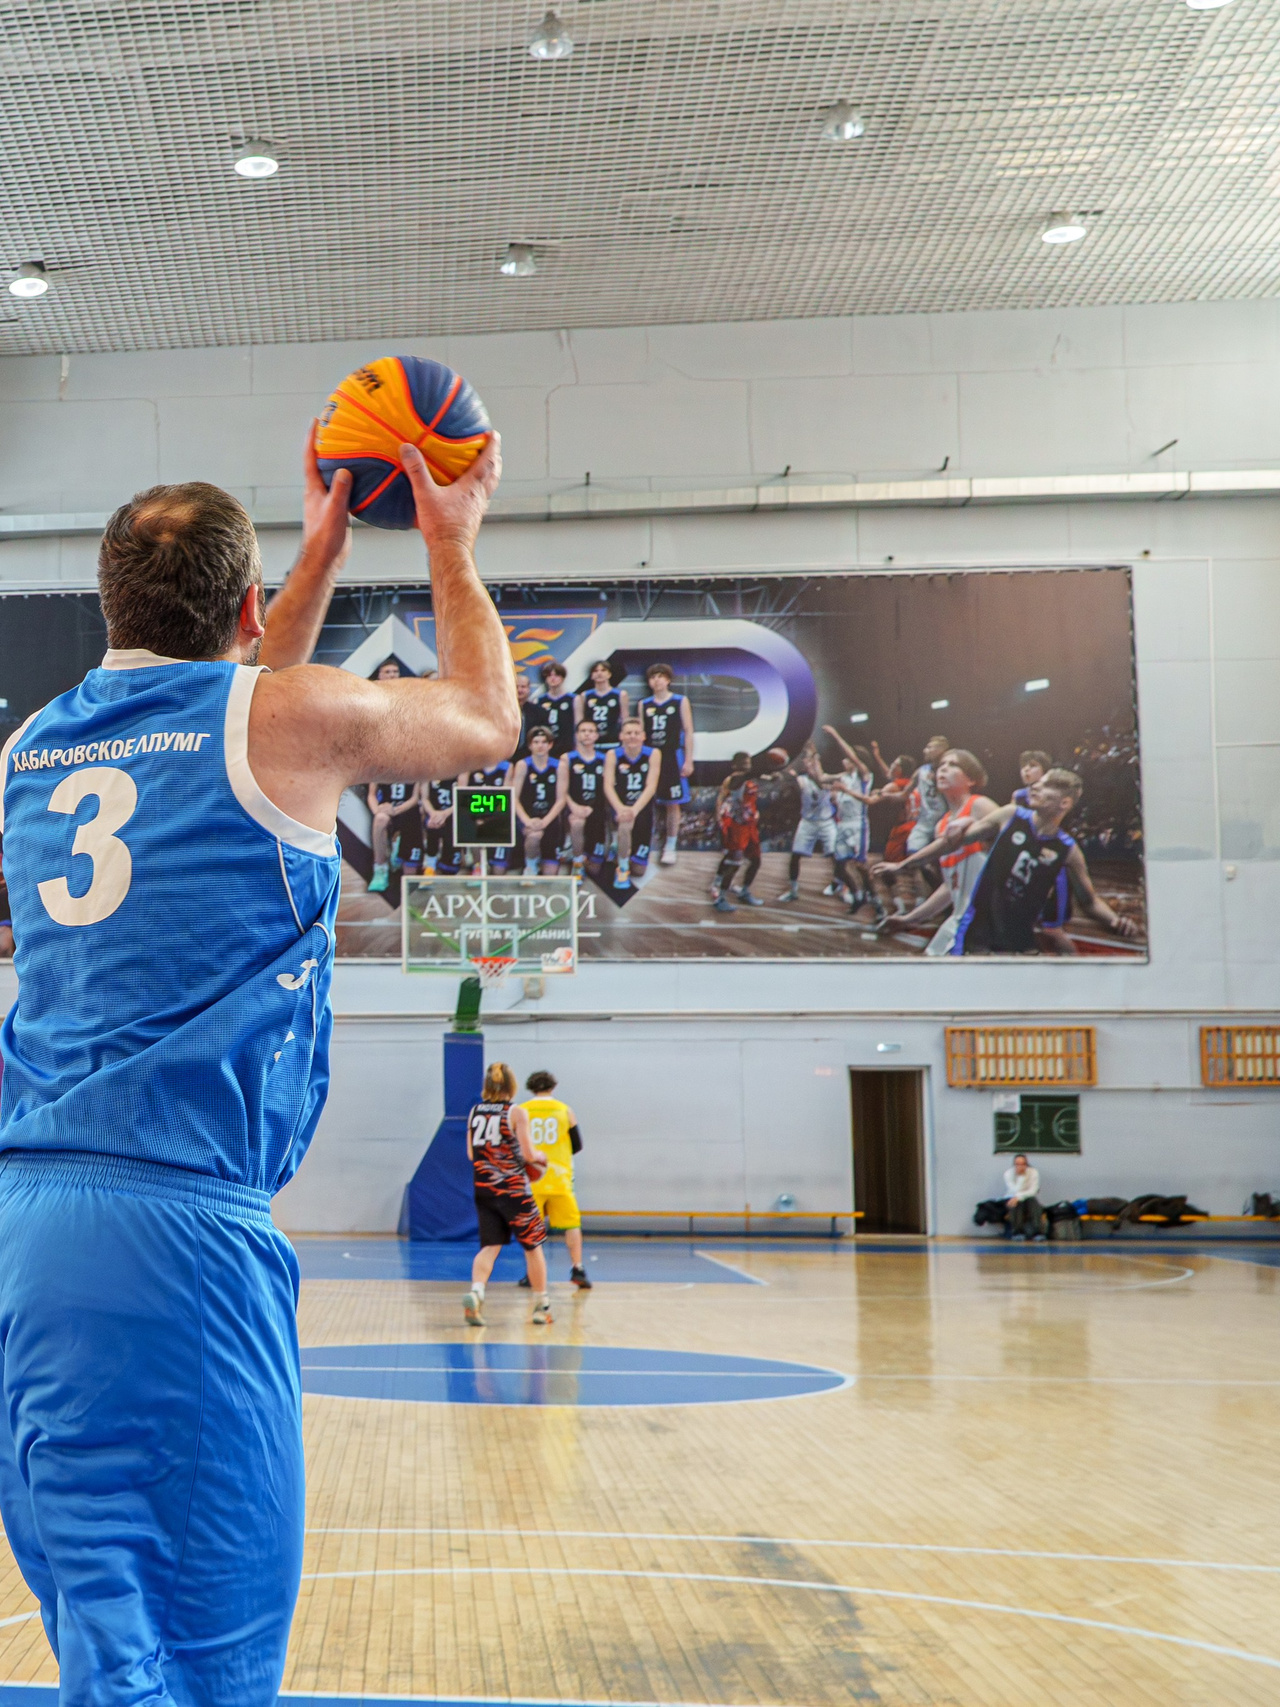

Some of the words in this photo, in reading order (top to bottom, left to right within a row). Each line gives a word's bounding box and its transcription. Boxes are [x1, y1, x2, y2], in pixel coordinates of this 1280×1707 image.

[626, 773, 642, 789] 12
[37, 766, 138, 926] 3
[420, 890, 598, 919] АРХСТРОЙ
[471, 1114, 502, 1146] 24
[529, 1117, 559, 1145] 68
